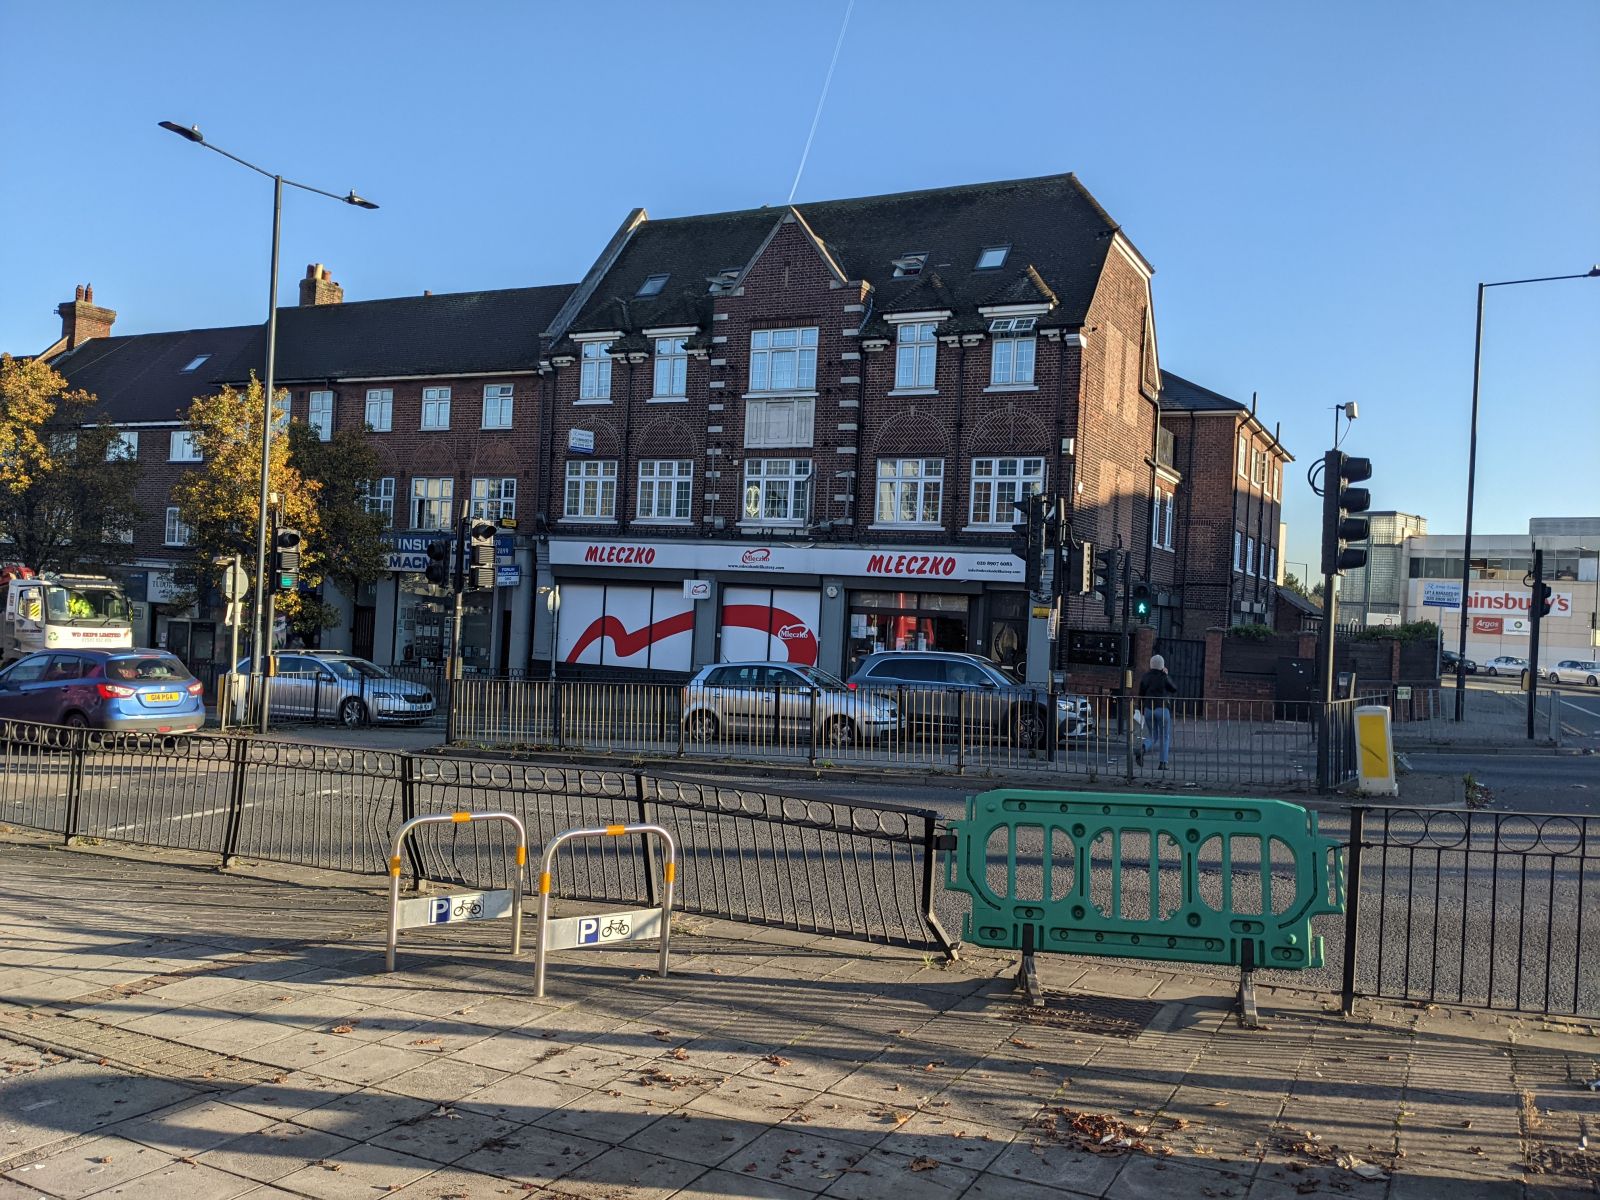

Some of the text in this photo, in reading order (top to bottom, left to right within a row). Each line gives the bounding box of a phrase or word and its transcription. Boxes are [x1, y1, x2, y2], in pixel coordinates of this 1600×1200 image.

[584, 545, 656, 564] MLECZKO
[866, 554, 956, 576] MLECZKO
[1475, 619, 1499, 628] Argos
[431, 900, 449, 923] P
[580, 919, 598, 944] P
